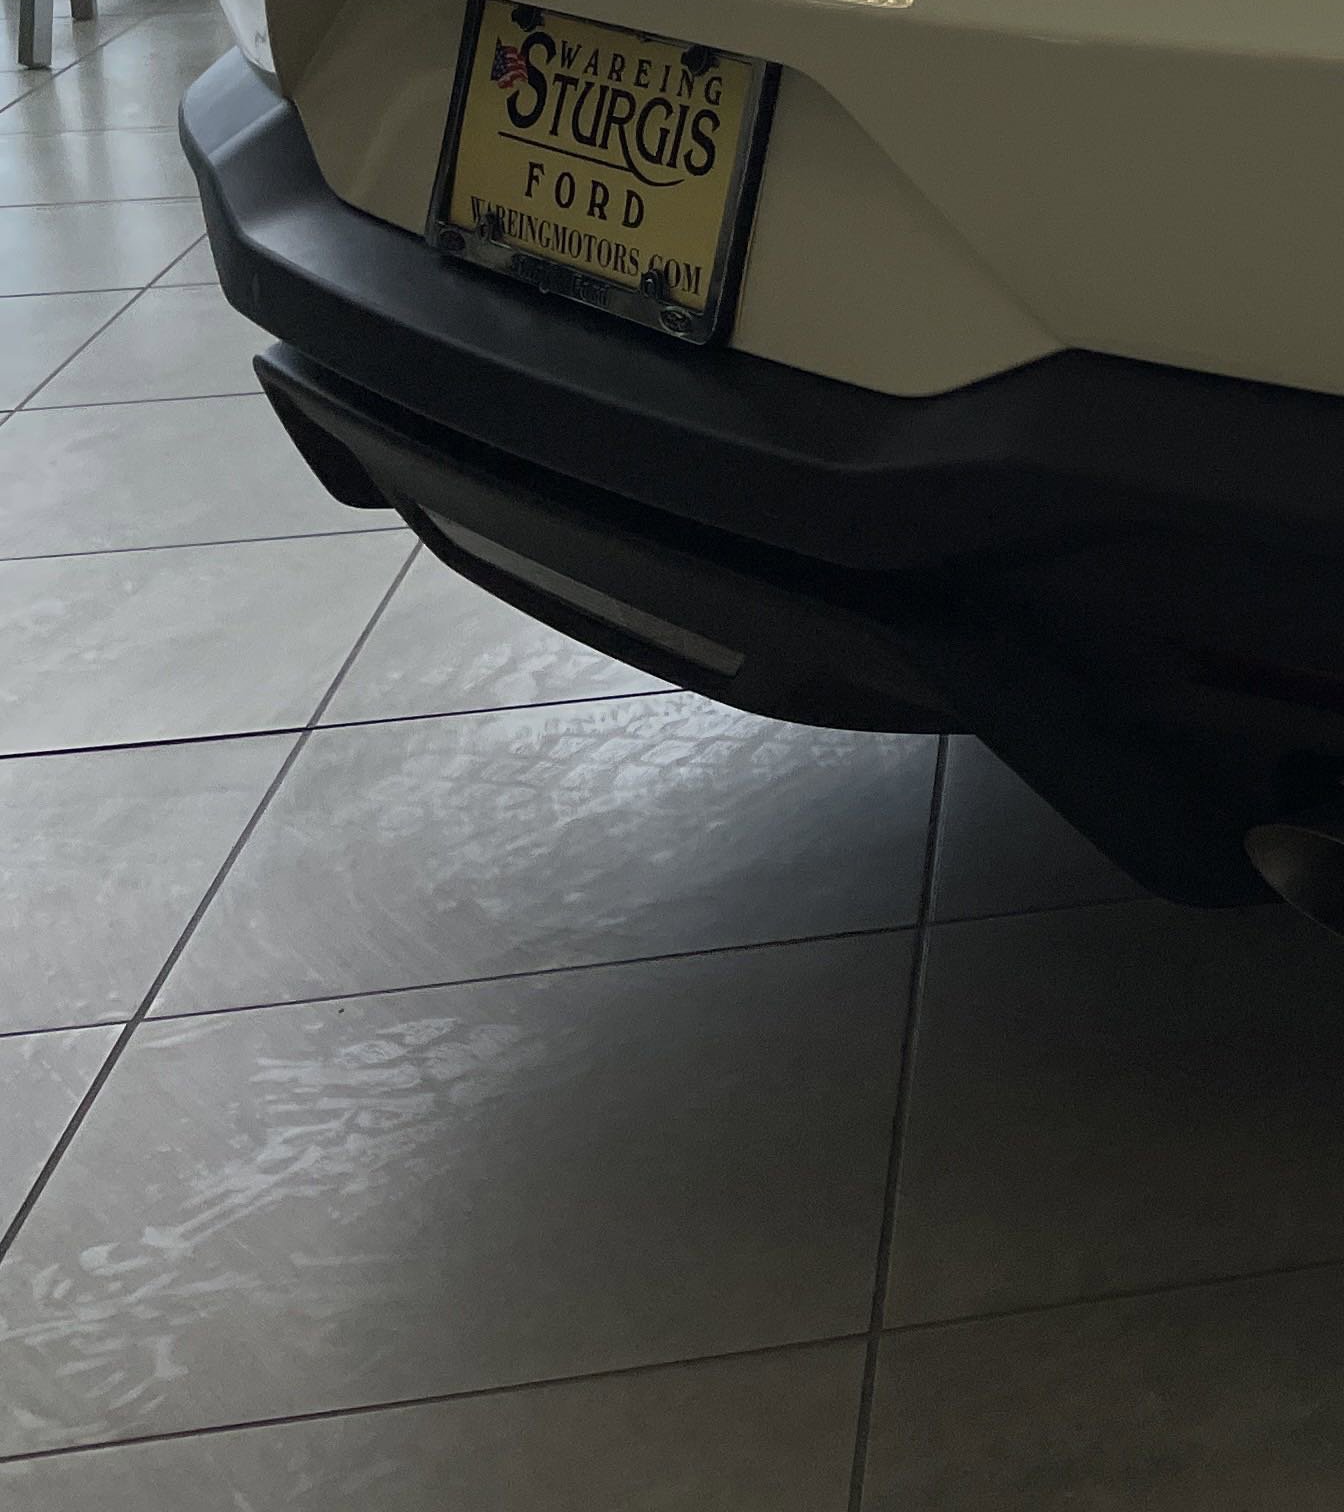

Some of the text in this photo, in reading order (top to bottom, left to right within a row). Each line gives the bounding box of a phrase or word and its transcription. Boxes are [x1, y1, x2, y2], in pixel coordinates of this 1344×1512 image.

[560, 40, 723, 105] WAREING
[506, 31, 721, 187] STURGIS
[524, 161, 645, 229] FORD
